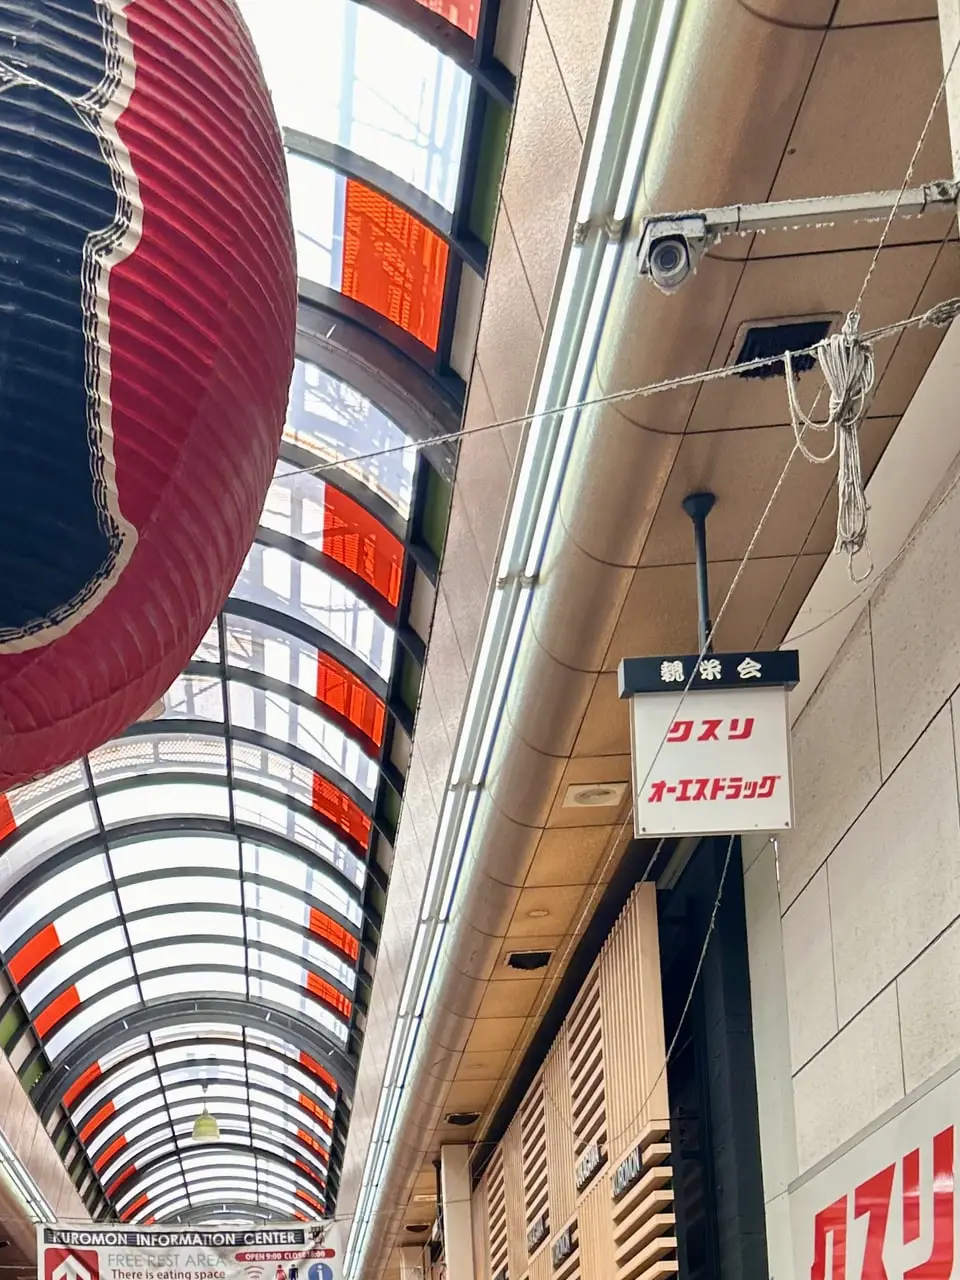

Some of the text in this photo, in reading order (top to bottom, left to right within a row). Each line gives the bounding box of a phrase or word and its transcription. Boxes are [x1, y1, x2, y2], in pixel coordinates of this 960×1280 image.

[660, 657, 762, 682] 親栄会
[667, 717, 755, 743] クスリ
[648, 775, 782, 803] オーエスドラッグ
[52, 1231, 297, 1247] KUROMON INFORMATION CENTER
[108, 1253, 227, 1268] FREE REST AREA
[245, 1253, 265, 1261] OPEN
[266, 1253, 282, 1261] 9:00
[112, 1269, 143, 1280] There
[145, 1269, 154, 1280] is
[194, 1270, 226, 1280] space
